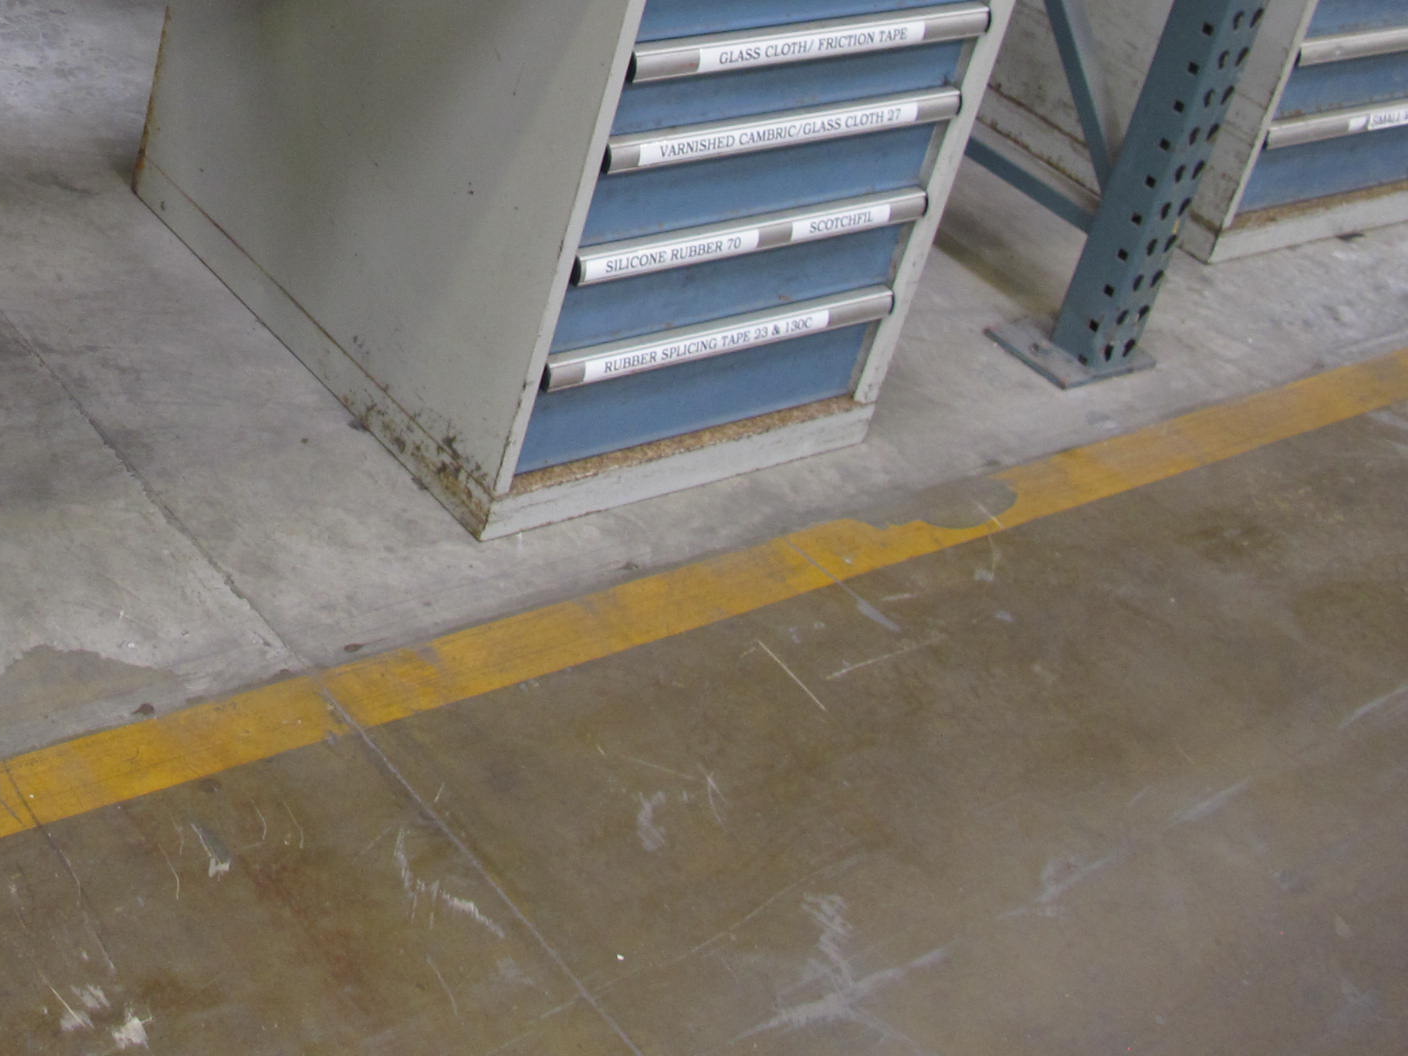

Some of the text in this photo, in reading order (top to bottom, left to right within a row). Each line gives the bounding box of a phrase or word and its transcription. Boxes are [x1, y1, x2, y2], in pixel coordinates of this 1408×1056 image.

[719, 27, 907, 65] GLASS CLOTH/ FRICTION TAPE
[659, 108, 901, 158] VARNISHED CAMBRIC/GLASS CLOTH 27
[809, 211, 873, 234] SCOTCHFIL
[605, 236, 741, 273] SILICONE RUBBER 70
[604, 316, 813, 373] RUBBER SPLICING TAPE 23 & 130C
